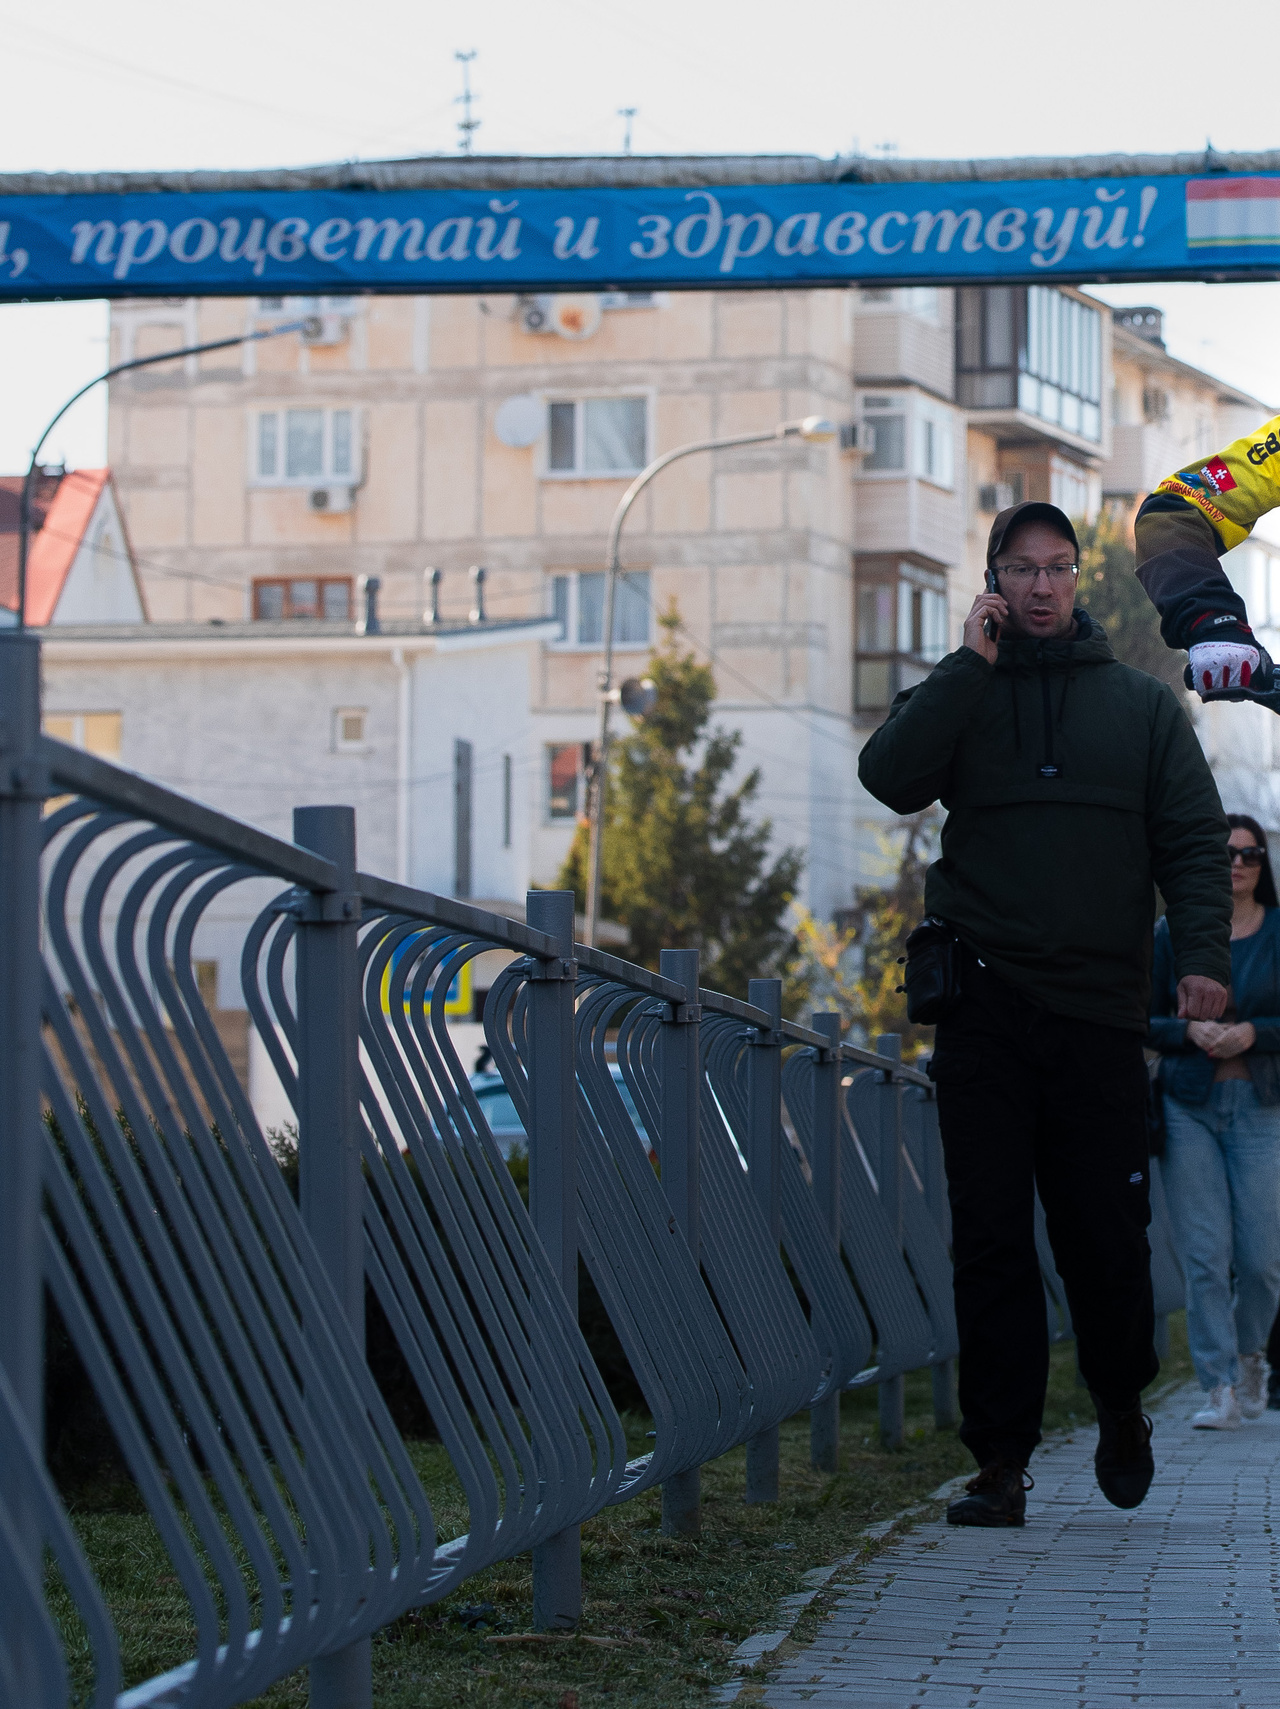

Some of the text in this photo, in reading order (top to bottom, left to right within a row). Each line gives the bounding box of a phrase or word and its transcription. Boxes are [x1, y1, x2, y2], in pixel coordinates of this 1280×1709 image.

[69, 199, 521, 280] процветай
[552, 215, 601, 262] и
[629, 185, 1158, 273] здравствуй!
[1192, 489, 1215, 514] ШКОЛА
